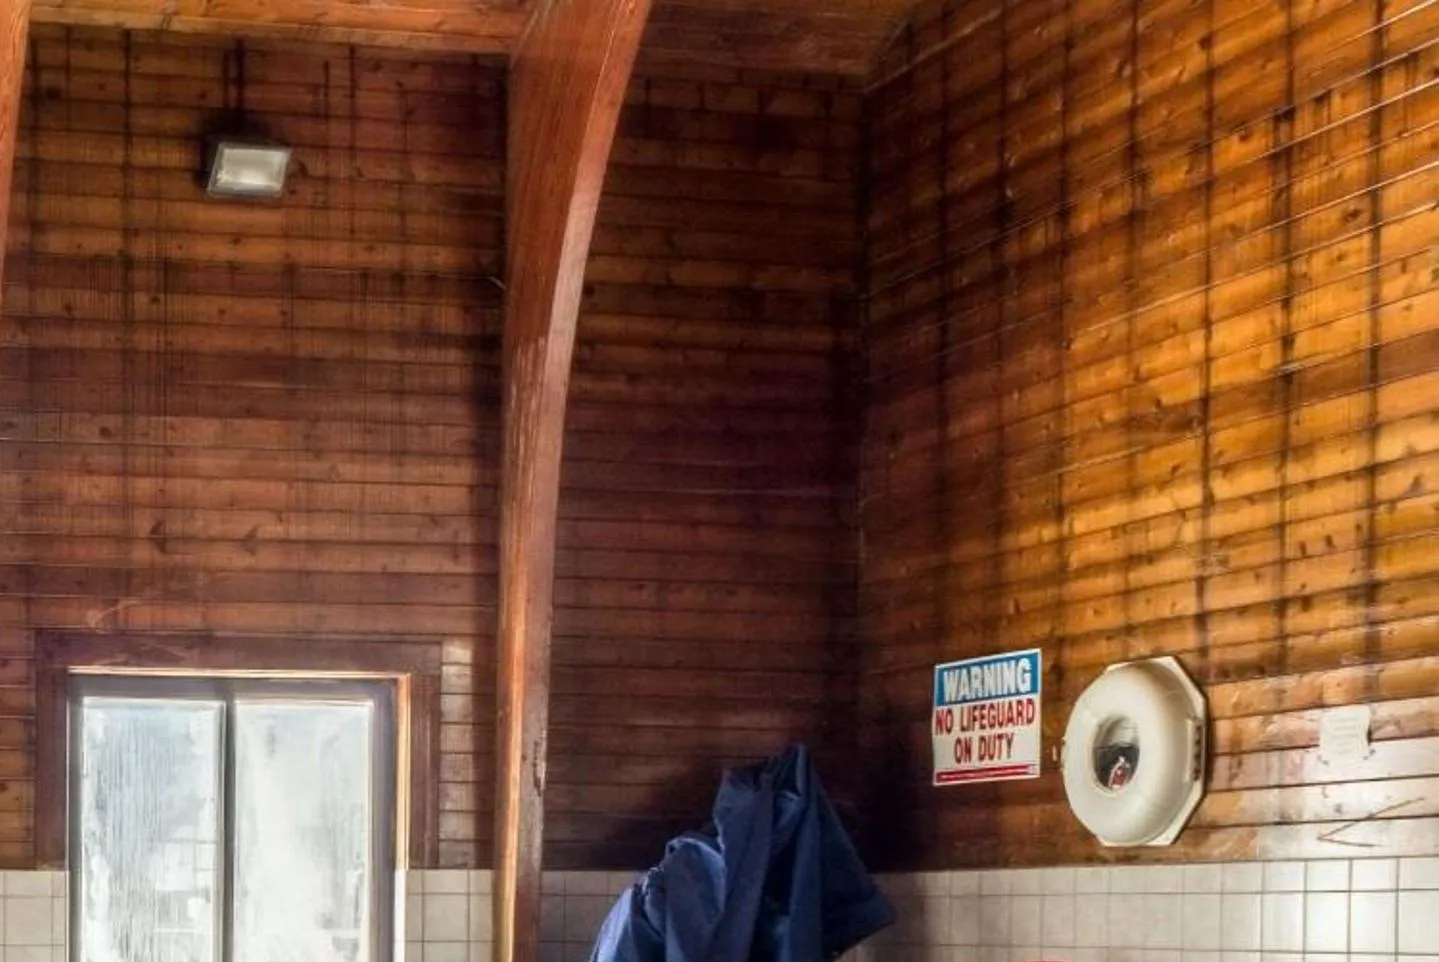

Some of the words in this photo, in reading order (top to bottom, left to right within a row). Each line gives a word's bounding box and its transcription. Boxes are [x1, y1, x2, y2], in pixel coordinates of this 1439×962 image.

[943, 657, 1032, 702] WARNING
[935, 707, 954, 736] NO
[960, 698, 1035, 732] LIFEGUARD
[954, 736, 972, 764] ON
[978, 732, 1015, 761] DUTY
